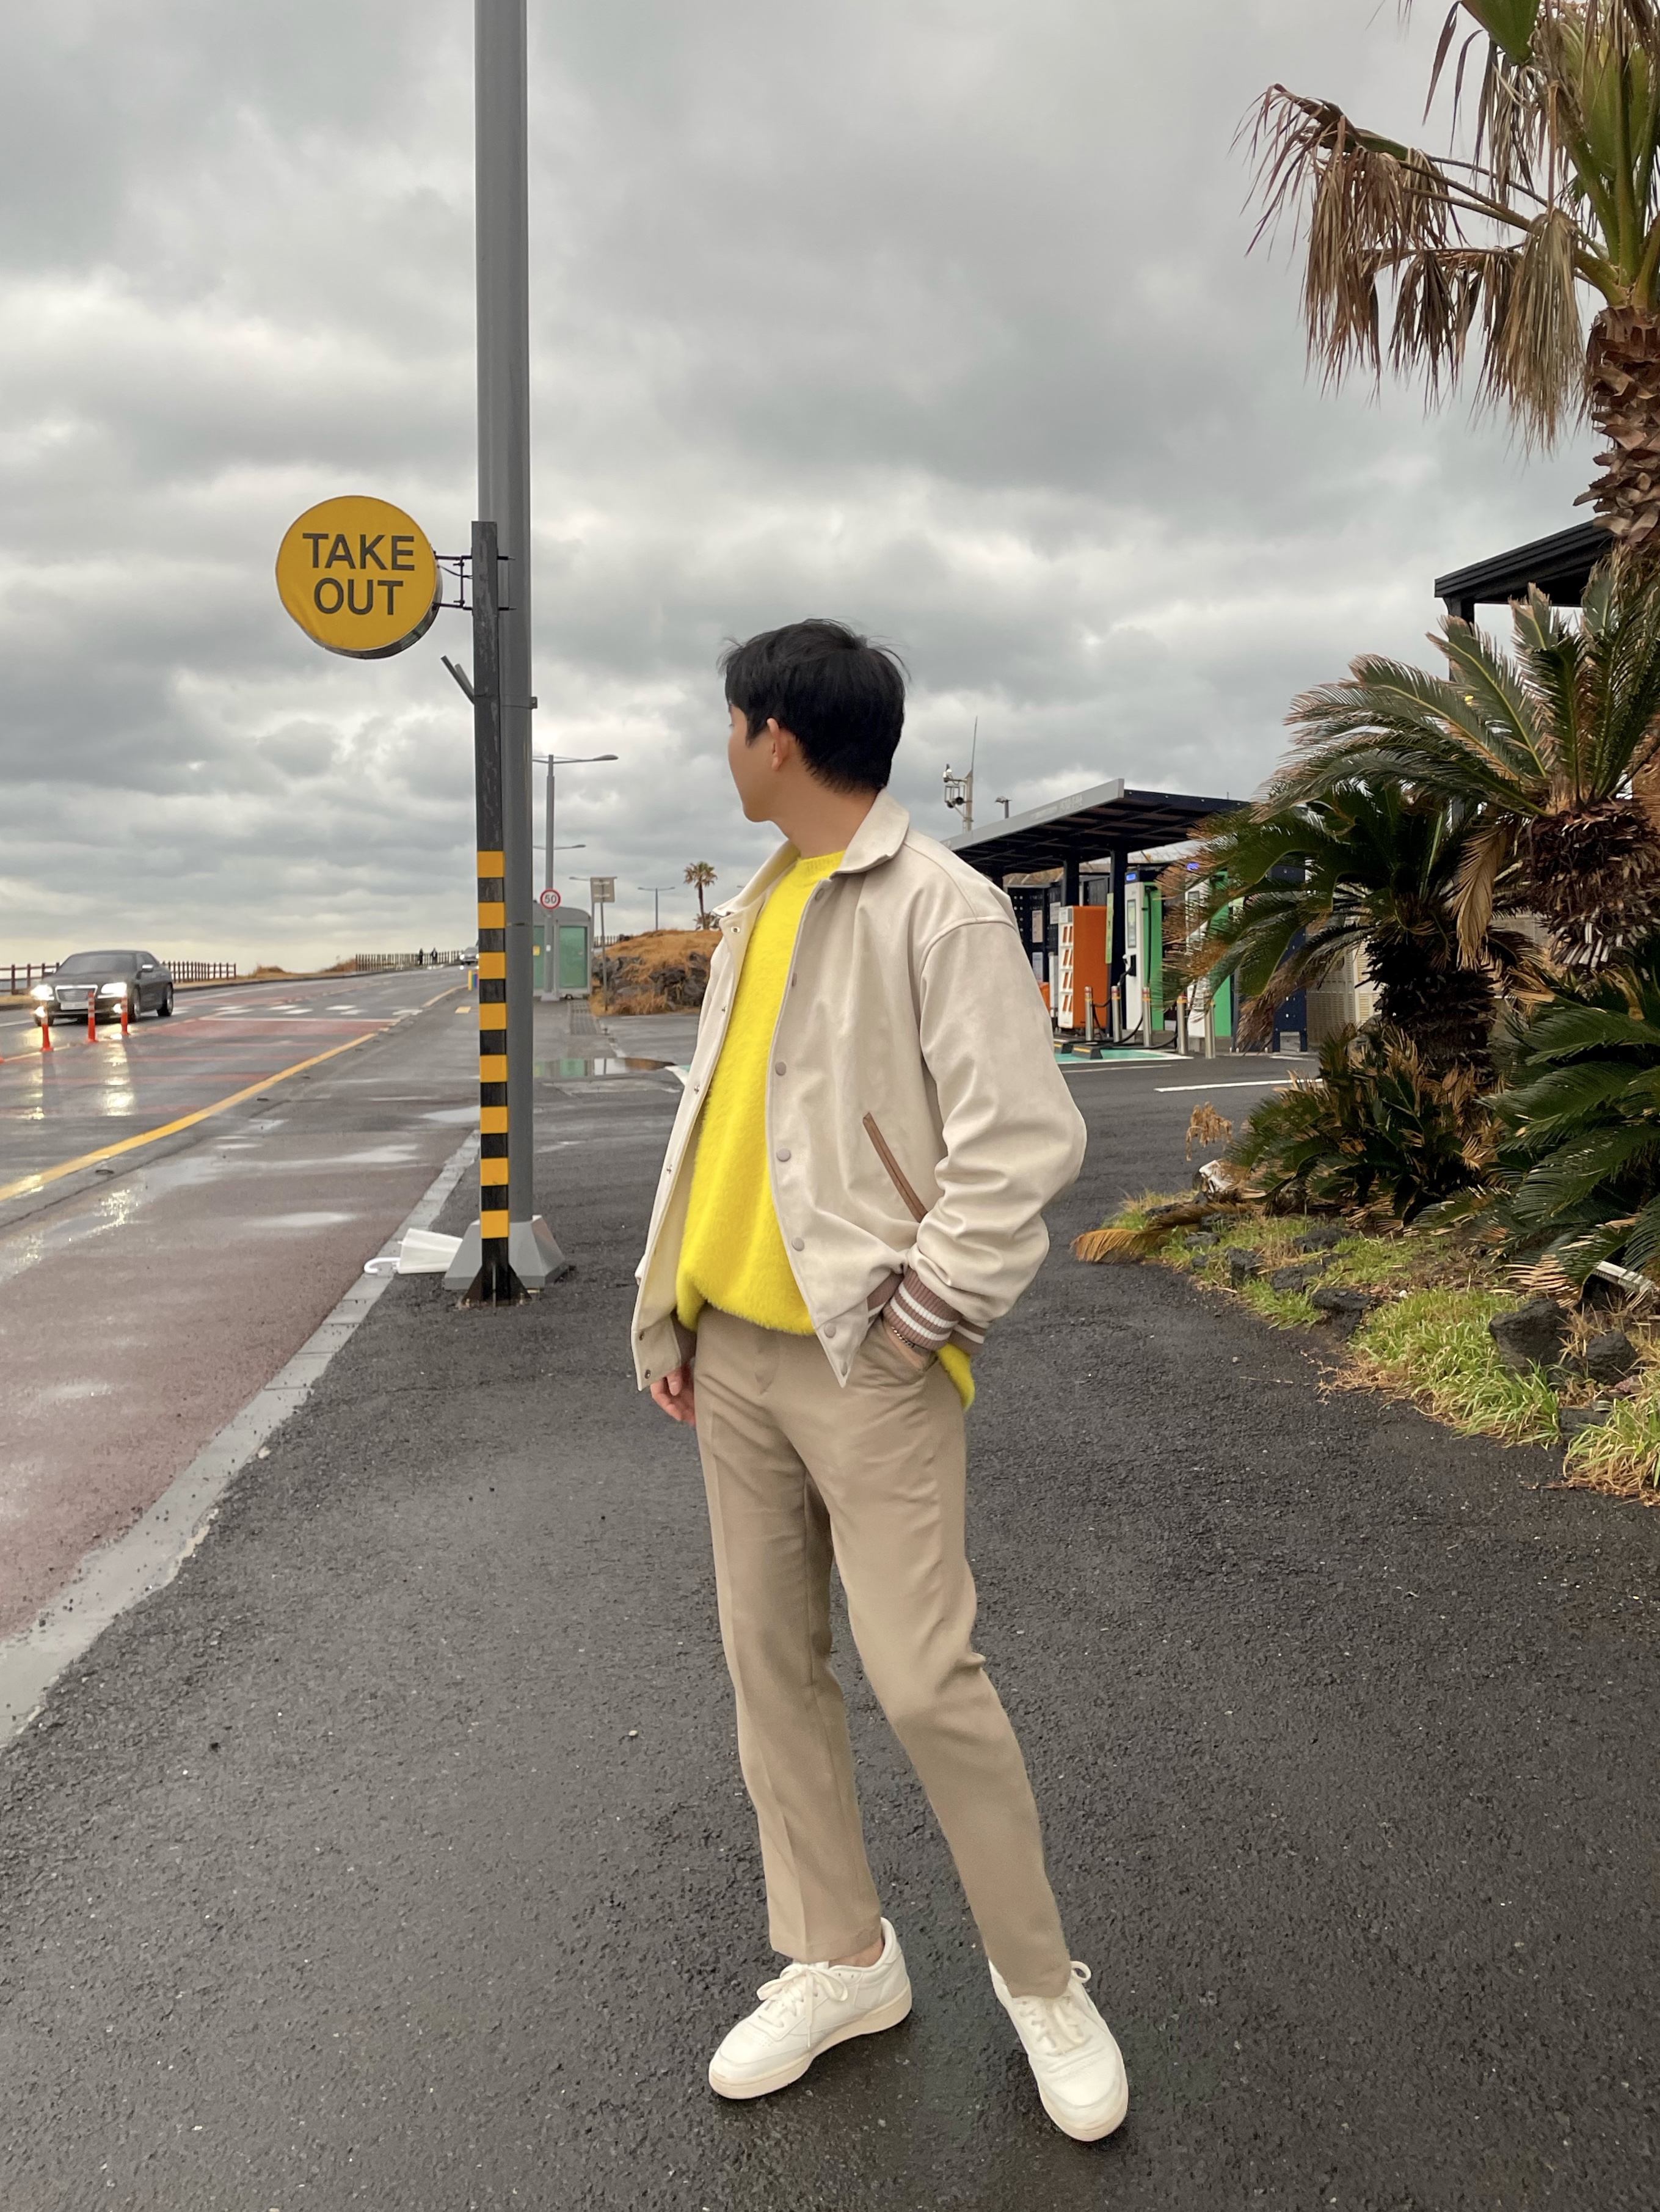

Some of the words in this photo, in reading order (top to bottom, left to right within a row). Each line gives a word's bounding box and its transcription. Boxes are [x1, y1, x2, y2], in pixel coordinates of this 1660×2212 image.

[302, 533, 415, 571] TAKE
[314, 577, 404, 615] OUT
[545, 894, 556, 904] 50
